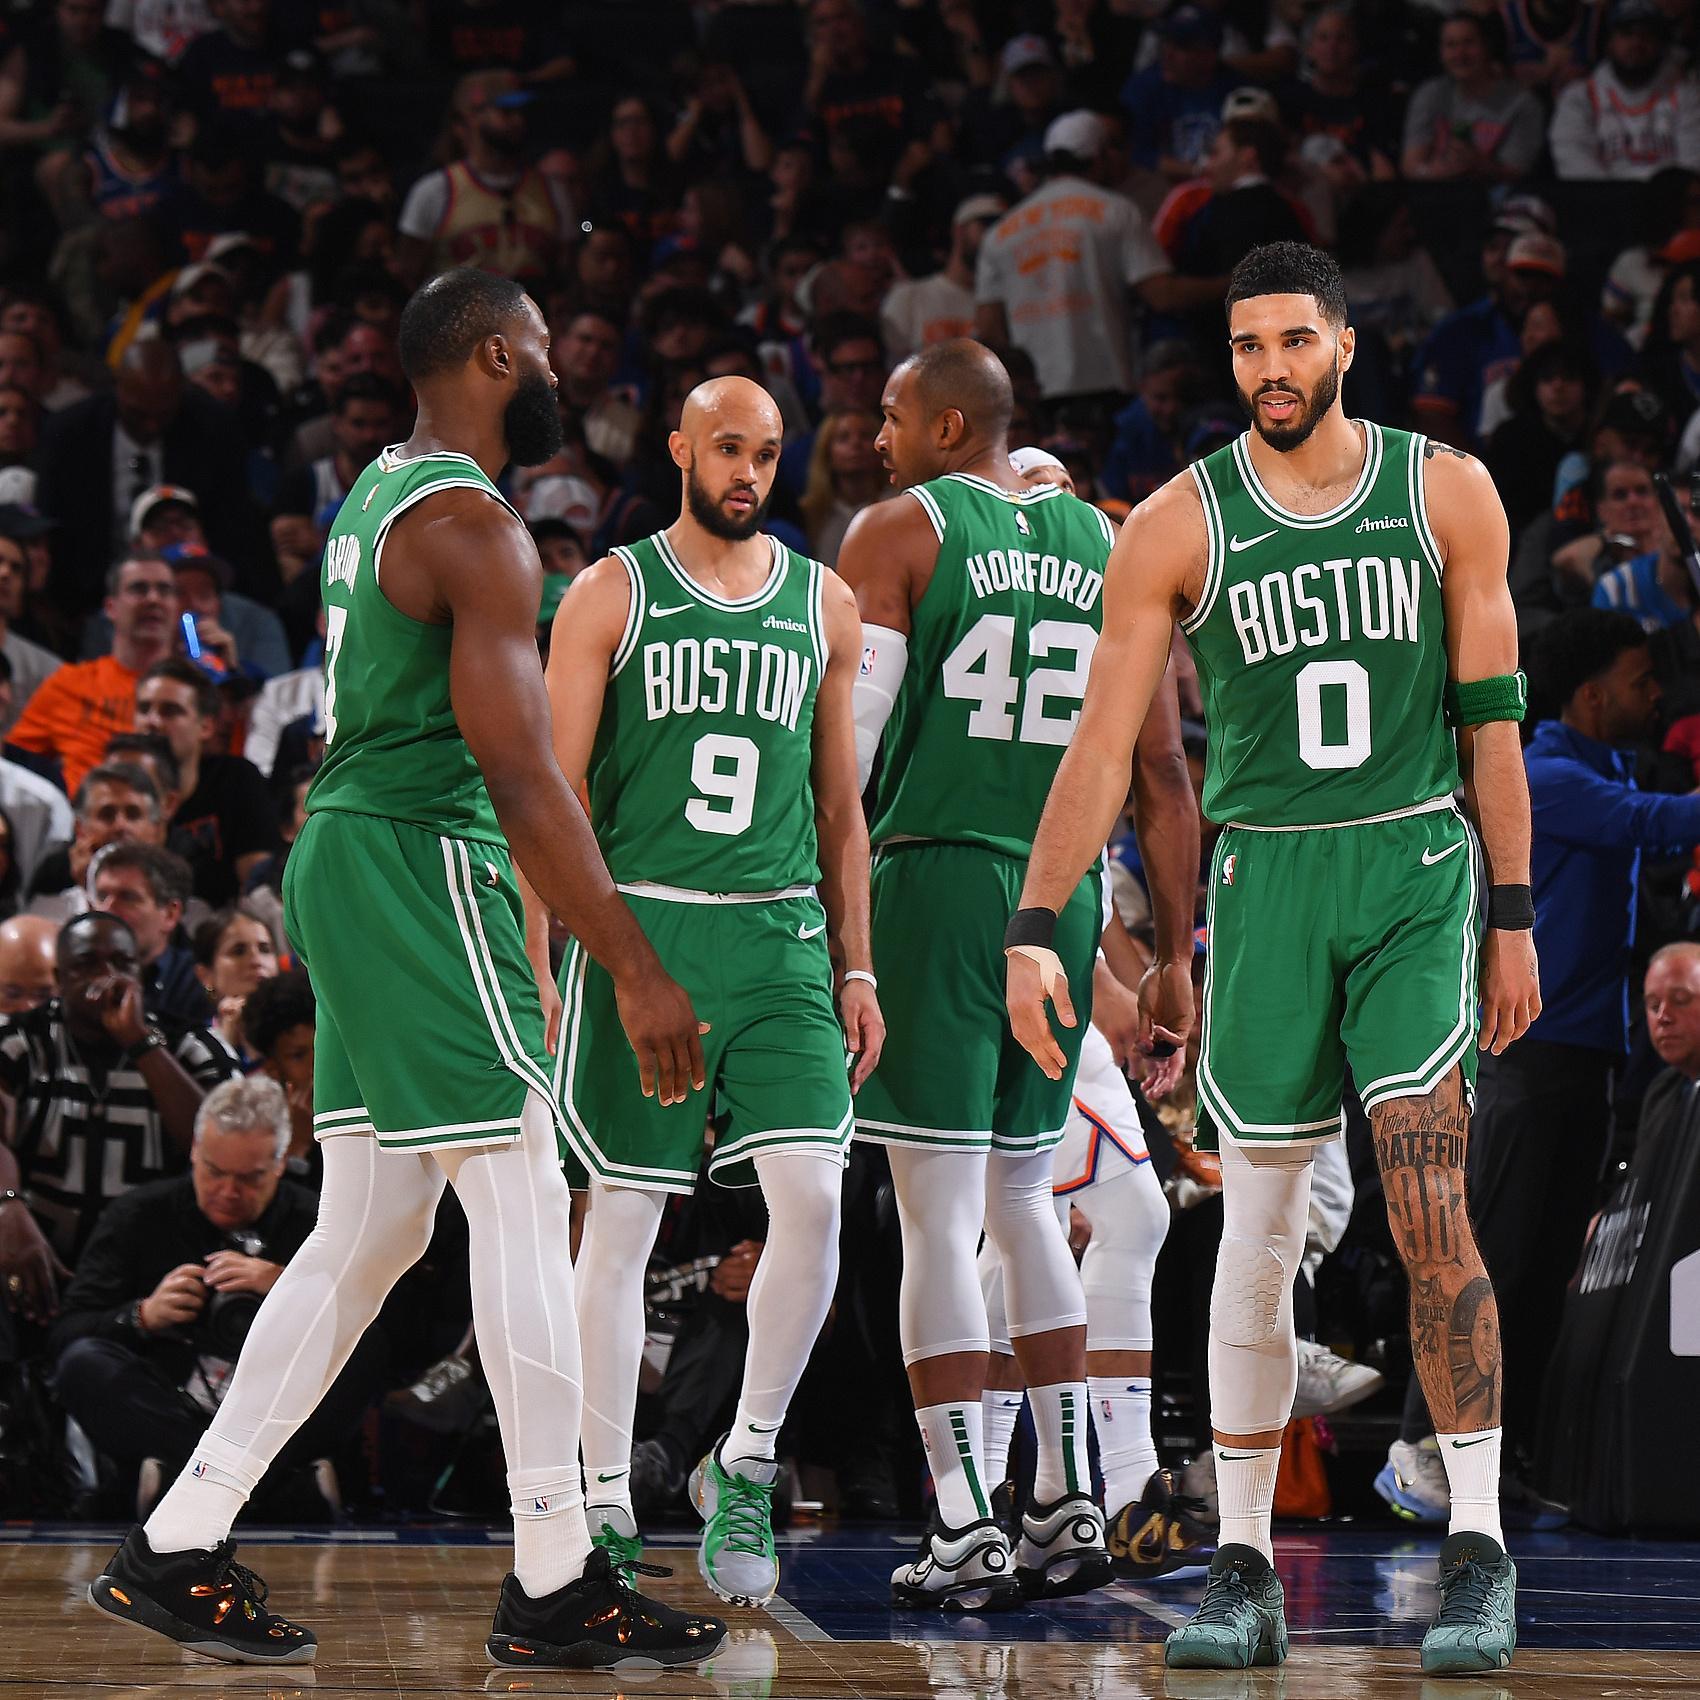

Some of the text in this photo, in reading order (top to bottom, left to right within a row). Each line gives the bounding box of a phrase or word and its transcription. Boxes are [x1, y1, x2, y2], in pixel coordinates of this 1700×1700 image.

[1354, 515, 1409, 534] Amica
[762, 614, 808, 634] Amica
[966, 548, 1104, 612] HORFORD
[1227, 556, 1420, 666] BOSTON
[643, 637, 812, 733] BOSTON
[942, 613, 1100, 747] 42
[1295, 659, 1372, 770] 0
[684, 733, 760, 836] 9
